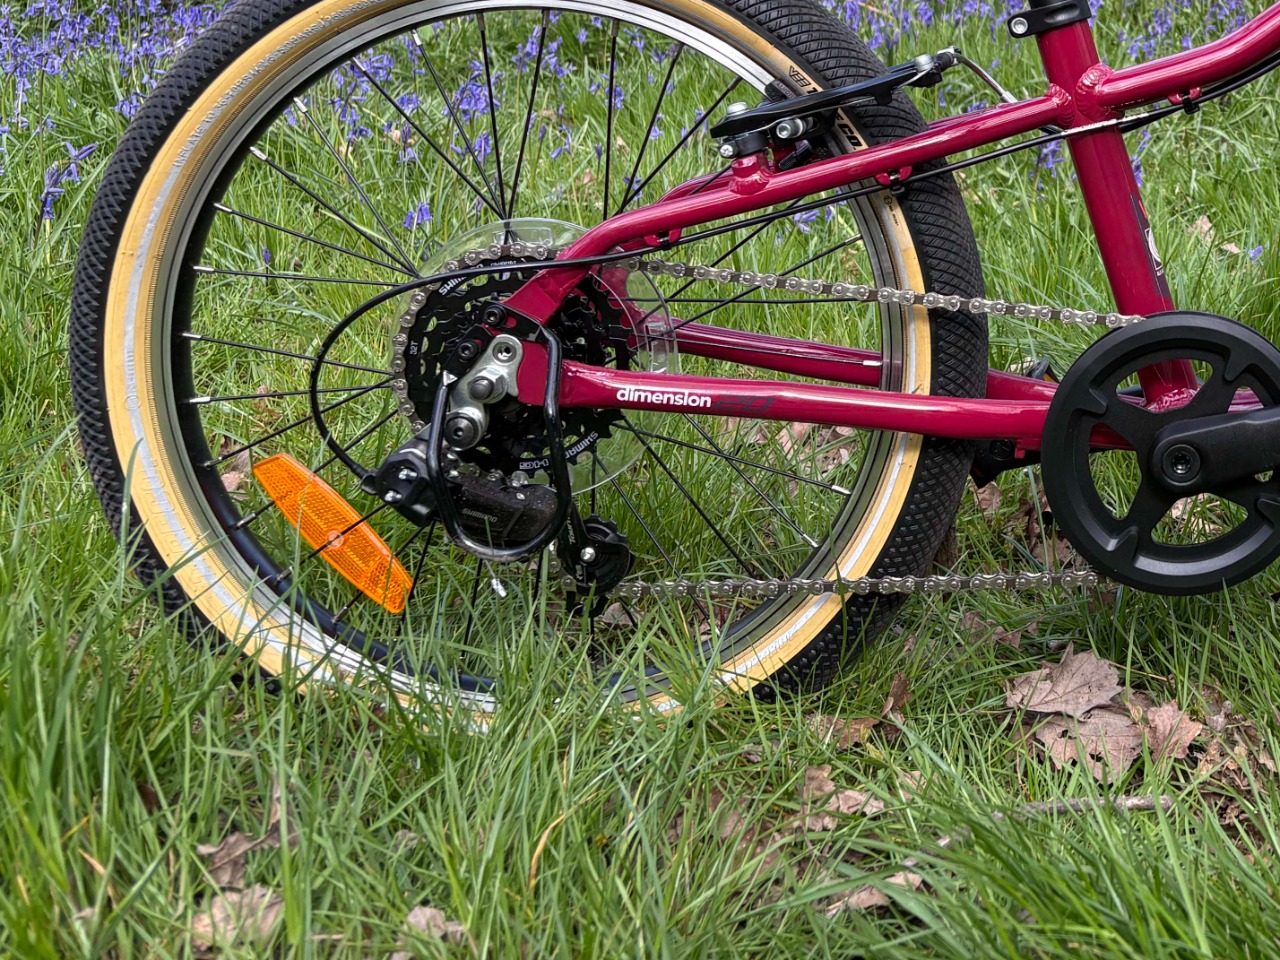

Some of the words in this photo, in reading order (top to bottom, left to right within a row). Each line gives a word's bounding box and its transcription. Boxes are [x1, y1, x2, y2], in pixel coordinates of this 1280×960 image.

[789, 65, 812, 88] VEE
[616, 387, 712, 408] dimension
[565, 431, 599, 459] SHIMAN
